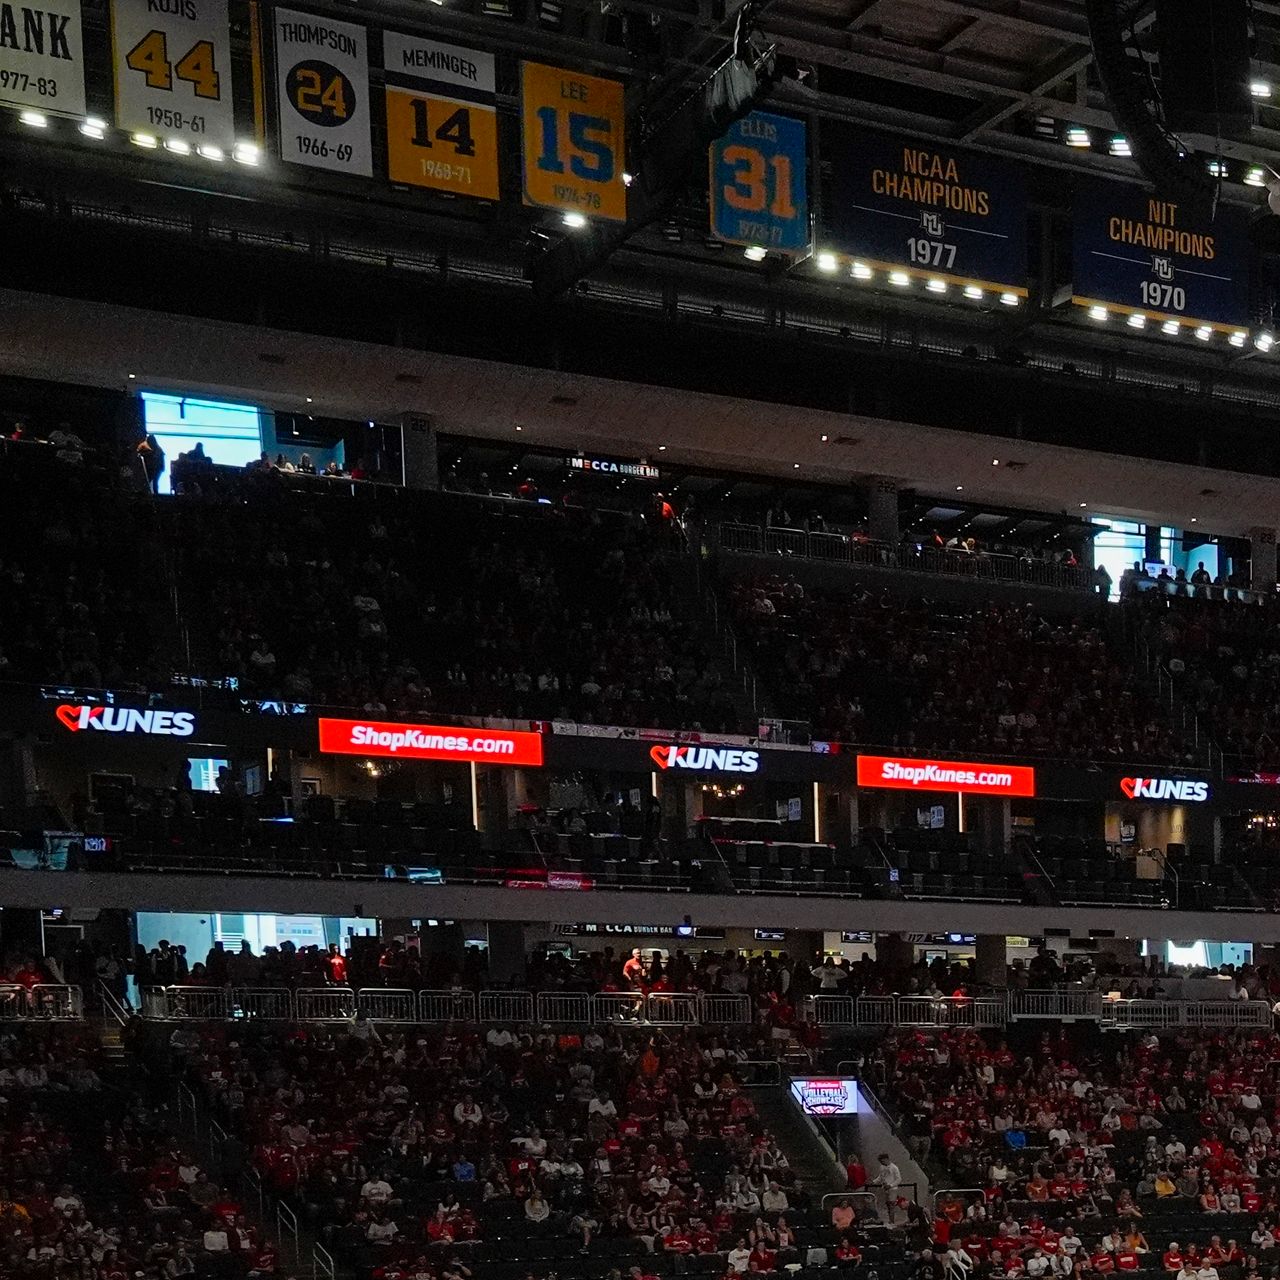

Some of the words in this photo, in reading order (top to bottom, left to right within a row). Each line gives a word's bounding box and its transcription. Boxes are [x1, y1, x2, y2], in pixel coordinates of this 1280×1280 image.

[280, 22, 358, 59] THOMPSON
[125, 29, 221, 101] 44
[402, 49, 478, 82] MEMINGER
[295, 68, 348, 119] 24
[560, 79, 589, 104] LEE
[146, 106, 206, 133] 1958-61
[410, 98, 476, 157] 14
[295, 135, 354, 163] 1966-69
[536, 105, 615, 185] 15
[722, 144, 797, 219] 31
[903, 148, 959, 184] NCAA
[871, 168, 990, 217] CHAMPIONS
[1148, 199, 1178, 227] NIT
[906, 236, 958, 271] 1977
[1108, 216, 1215, 260] CHAMPIONS
[1139, 279, 1186, 312] 1970
[571, 457, 619, 475] MECCA
[79, 705, 194, 737] KUNES
[351, 725, 514, 755] ShopKunes.com
[666, 745, 759, 773] KUNES
[881, 762, 1012, 788] ShopKunes.com
[1133, 778, 1209, 802] KUNES
